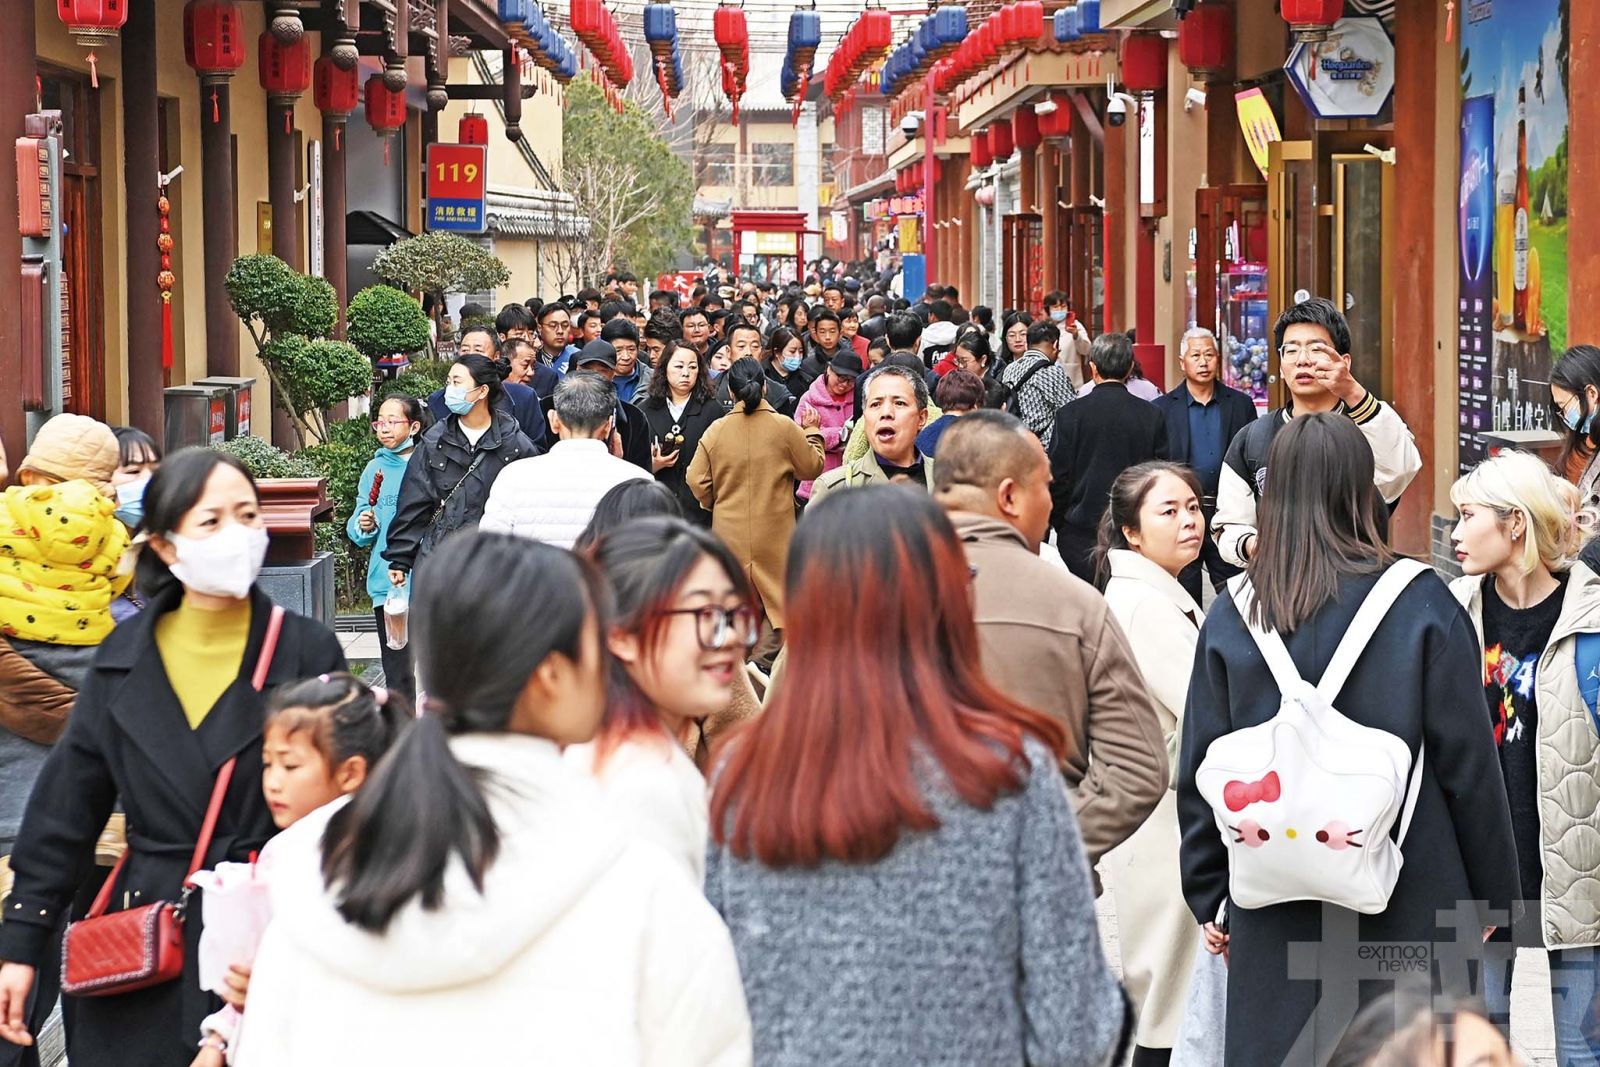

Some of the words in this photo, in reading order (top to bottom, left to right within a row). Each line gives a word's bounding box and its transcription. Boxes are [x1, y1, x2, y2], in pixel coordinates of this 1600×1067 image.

[1322, 59, 1371, 71] Hoegaarden
[436, 163, 478, 182] 119
[436, 206, 476, 217] 消防救援
